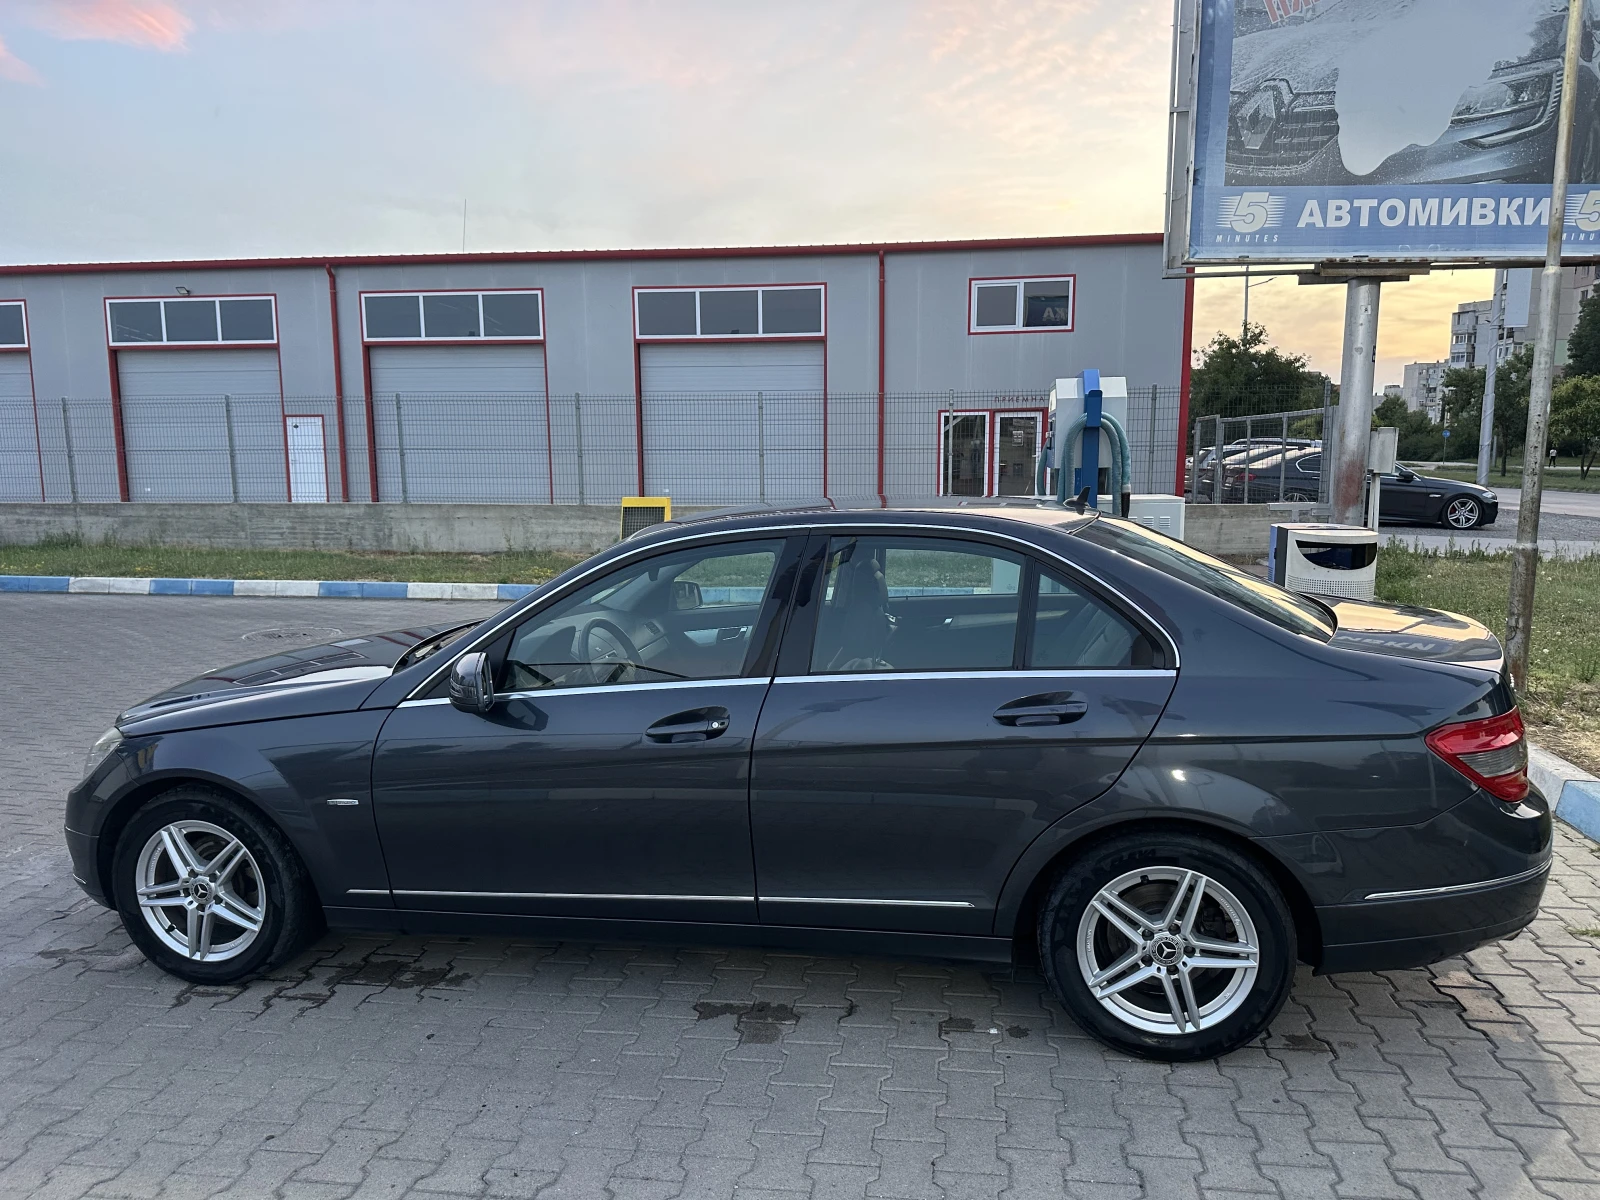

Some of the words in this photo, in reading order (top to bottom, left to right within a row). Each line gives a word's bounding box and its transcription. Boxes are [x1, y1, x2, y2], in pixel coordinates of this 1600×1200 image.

[1230, 192, 1270, 233] 5
[1297, 197, 1551, 228] АВТОМИВКИ
[1215, 234, 1279, 243] MINUTES
[994, 395, 1045, 403] ПРИЕМНА
